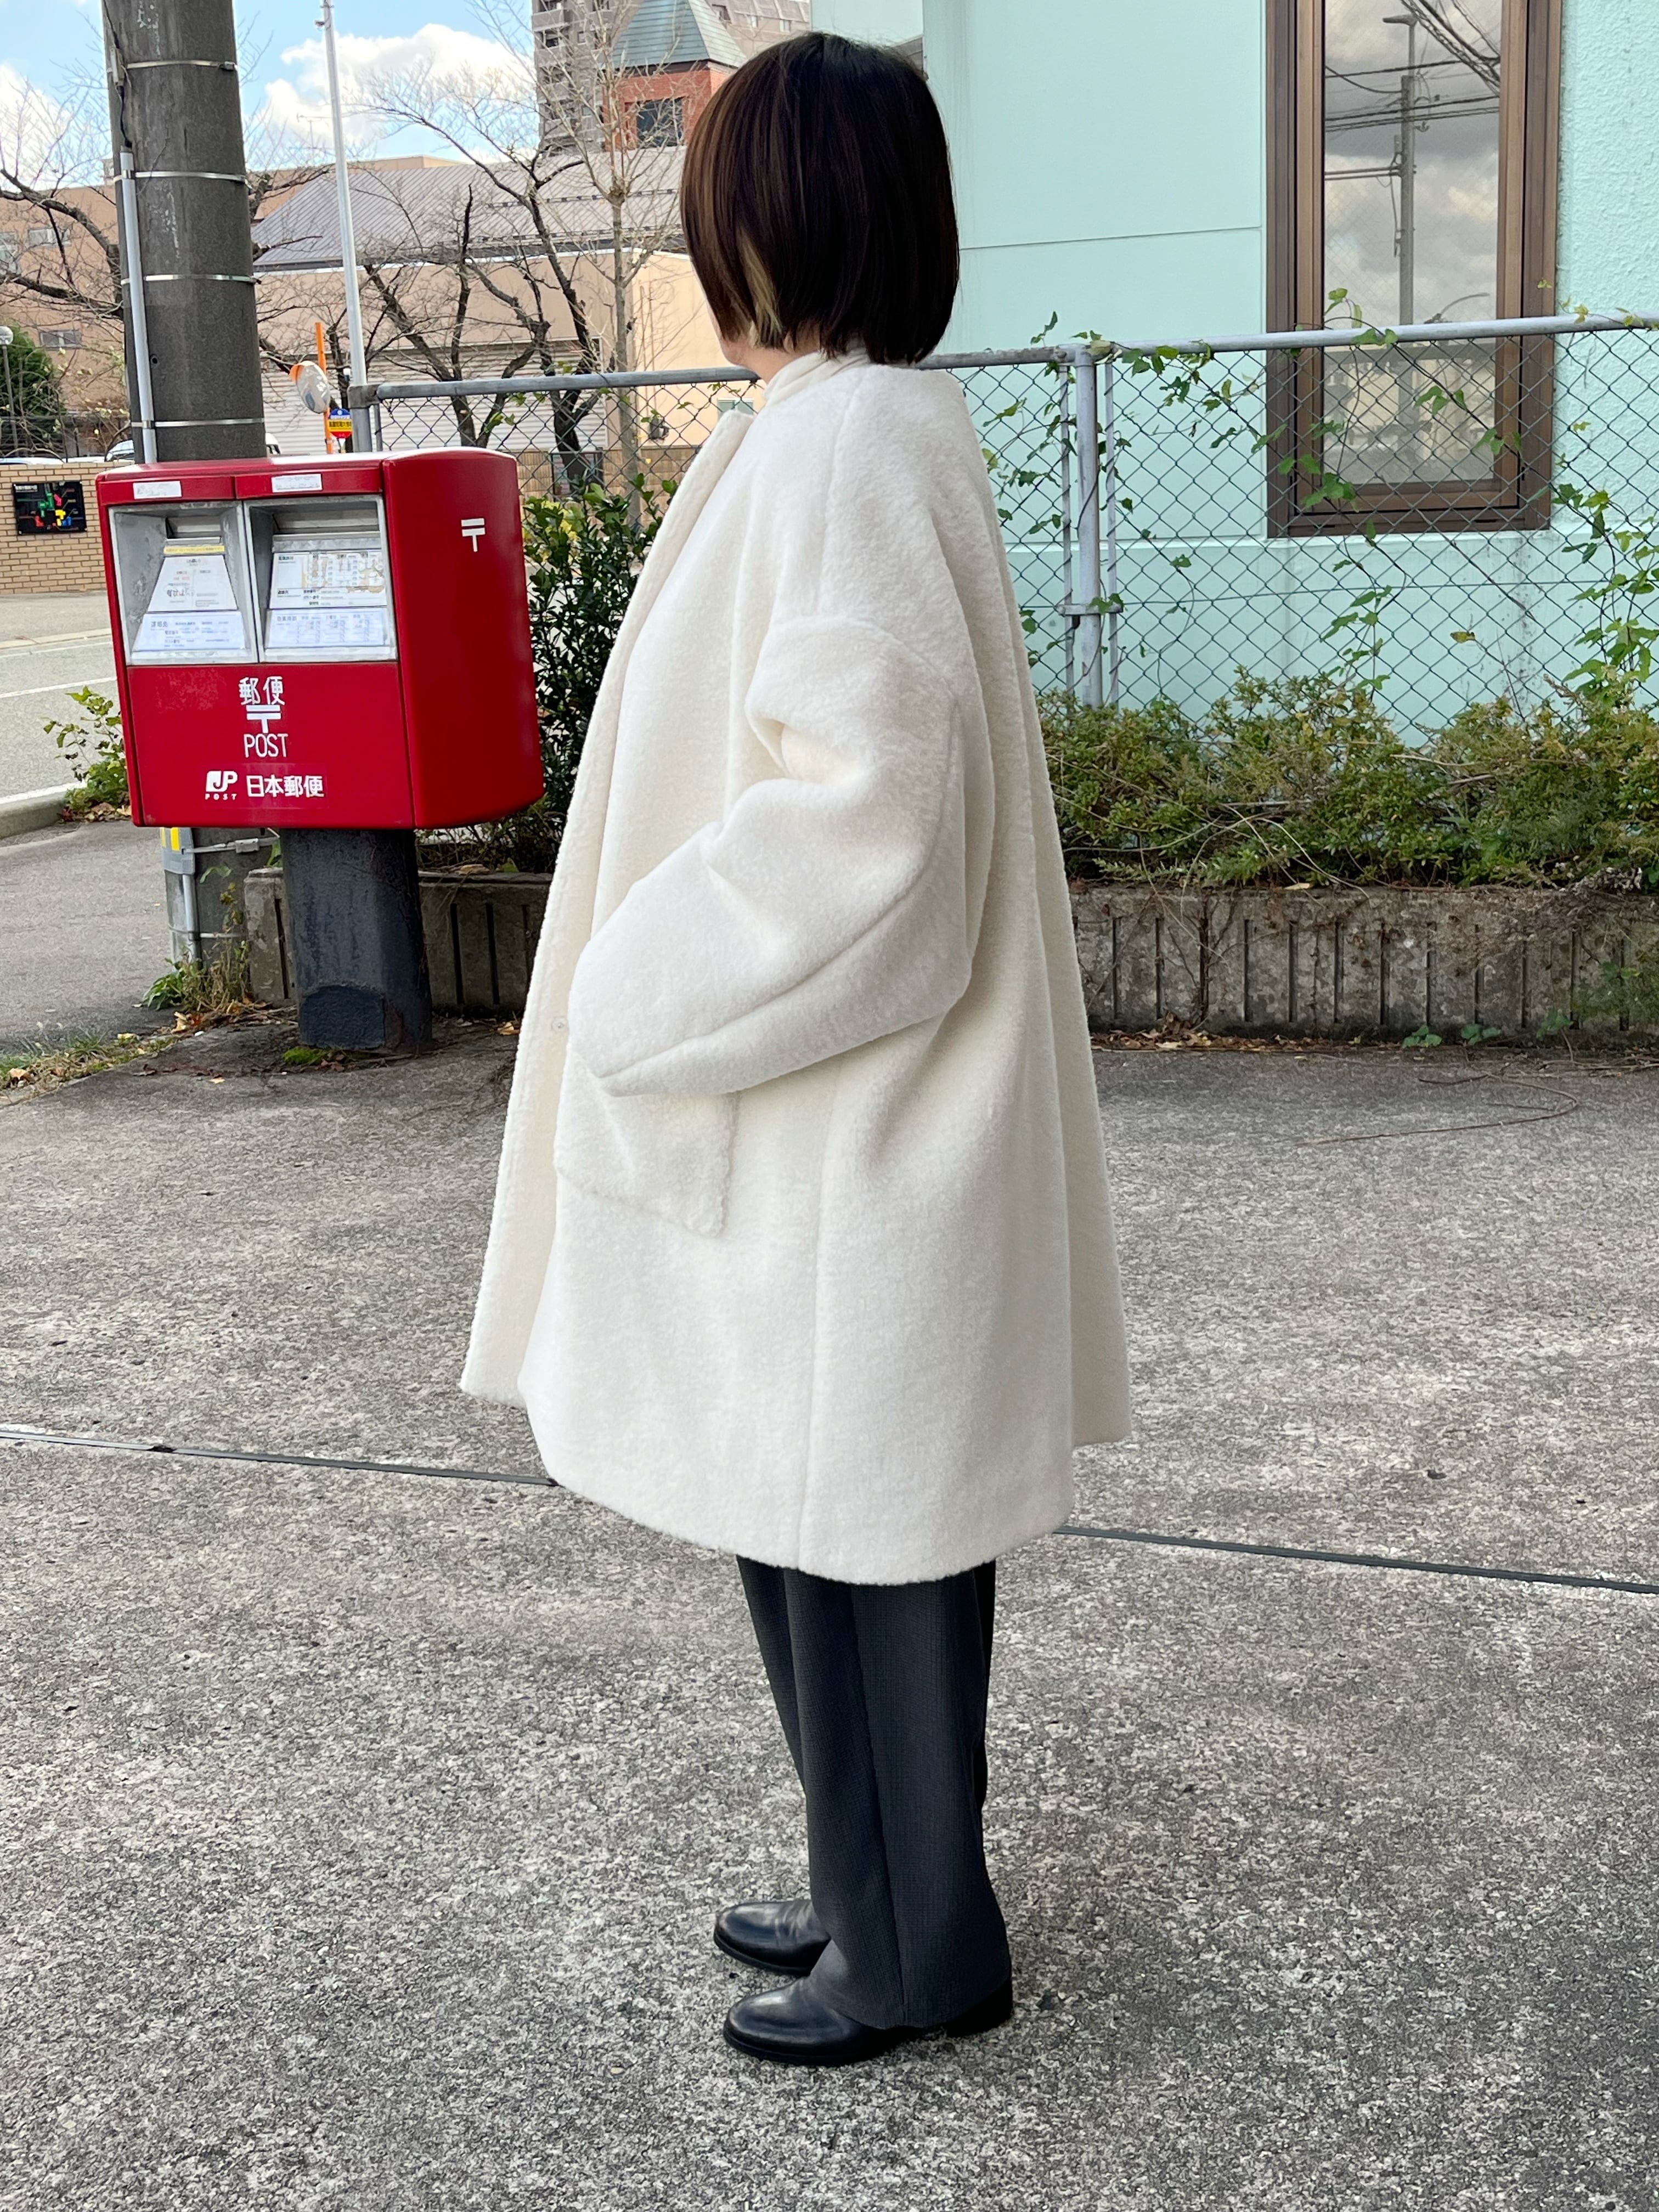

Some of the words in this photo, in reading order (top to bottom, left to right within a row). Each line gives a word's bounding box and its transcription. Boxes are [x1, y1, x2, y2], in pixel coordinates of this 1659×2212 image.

[239, 676, 285, 706] 郵便
[244, 733, 289, 758] POST
[246, 774, 325, 798] 日本郵便
